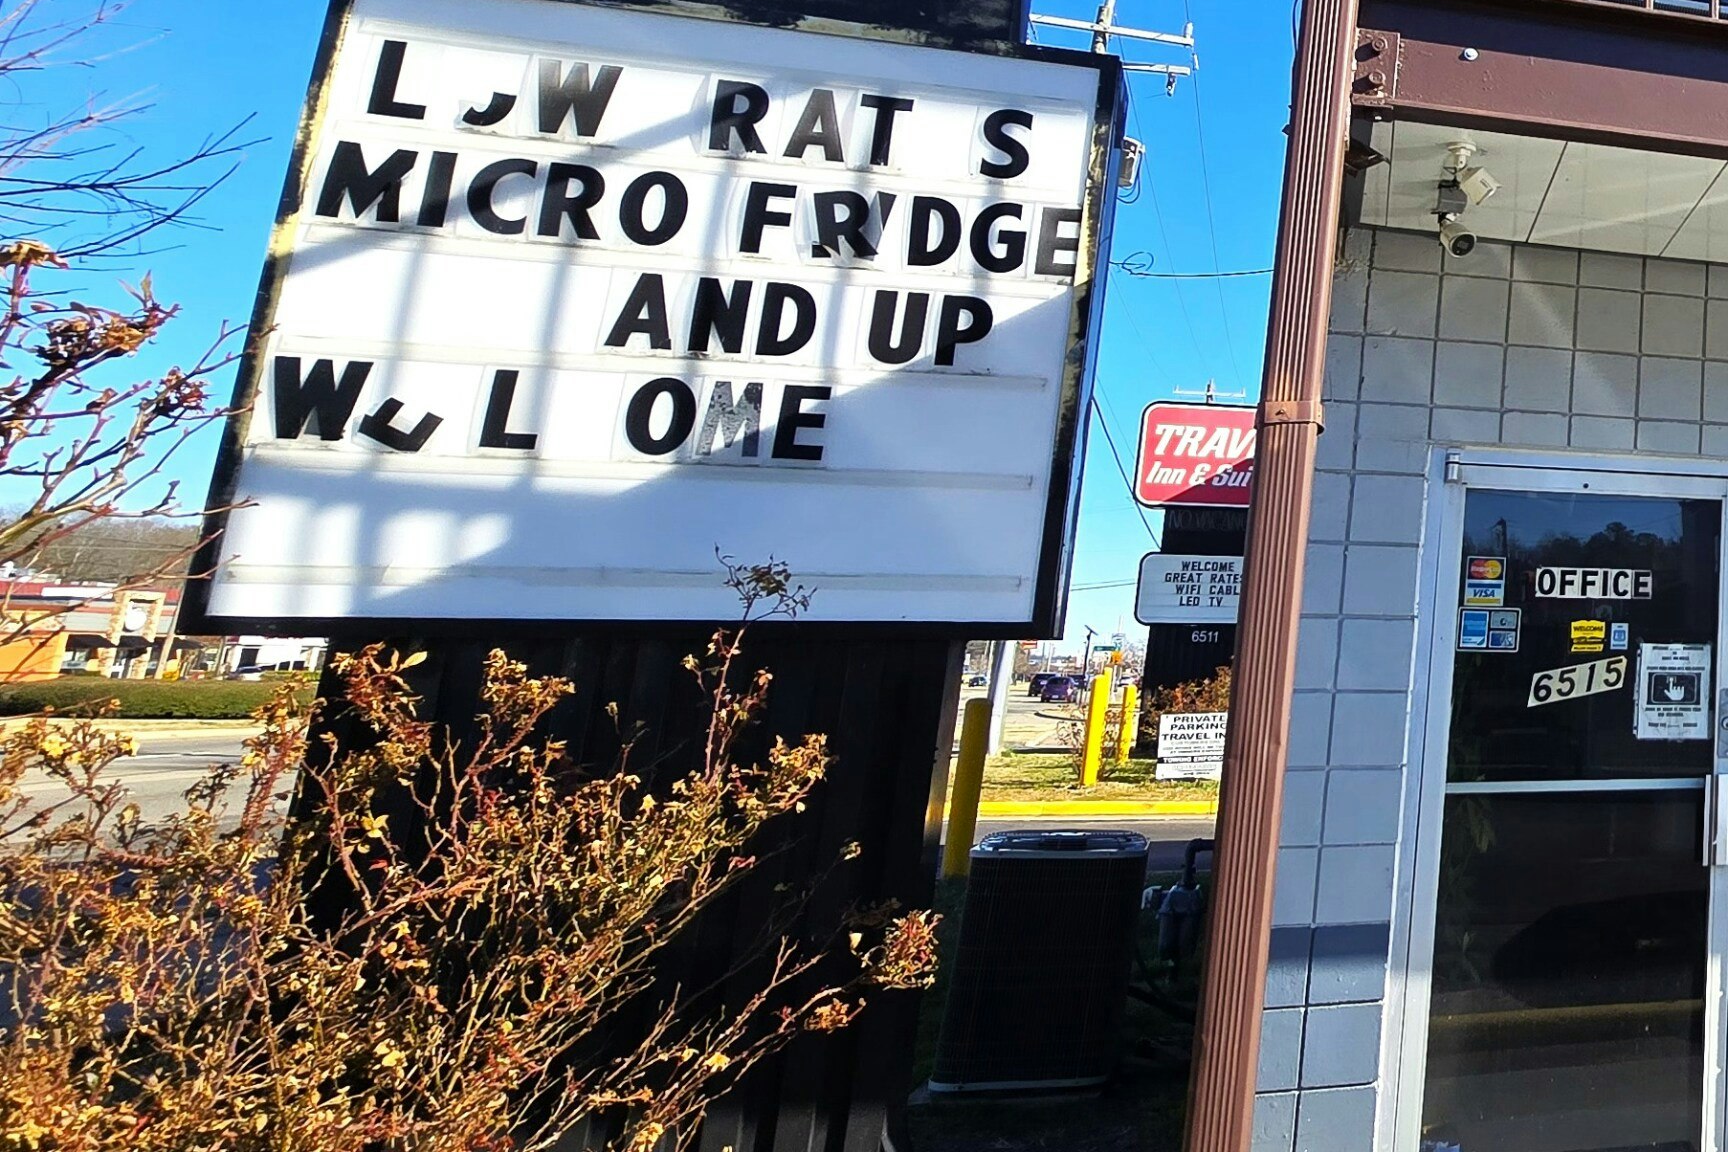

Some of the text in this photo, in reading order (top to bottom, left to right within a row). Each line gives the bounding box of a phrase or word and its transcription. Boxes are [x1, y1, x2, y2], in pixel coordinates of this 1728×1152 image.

[315, 142, 688, 246] MICRO
[604, 273, 993, 366] AND UP
[1146, 461, 1187, 485] Inn
[1188, 463, 1211, 485] &
[1181, 560, 1235, 572] WELCOME
[1165, 572, 1203, 583] GREAT
[1538, 568, 1650, 597] OFFICE
[1175, 584, 1201, 595] WIFI
[1473, 589, 1496, 598] VISA
[1179, 596, 1224, 607] LED TV
[1191, 631, 1219, 643] 6511
[1533, 658, 1623, 703] 6515
[1161, 732, 1210, 741] TRAVEL
